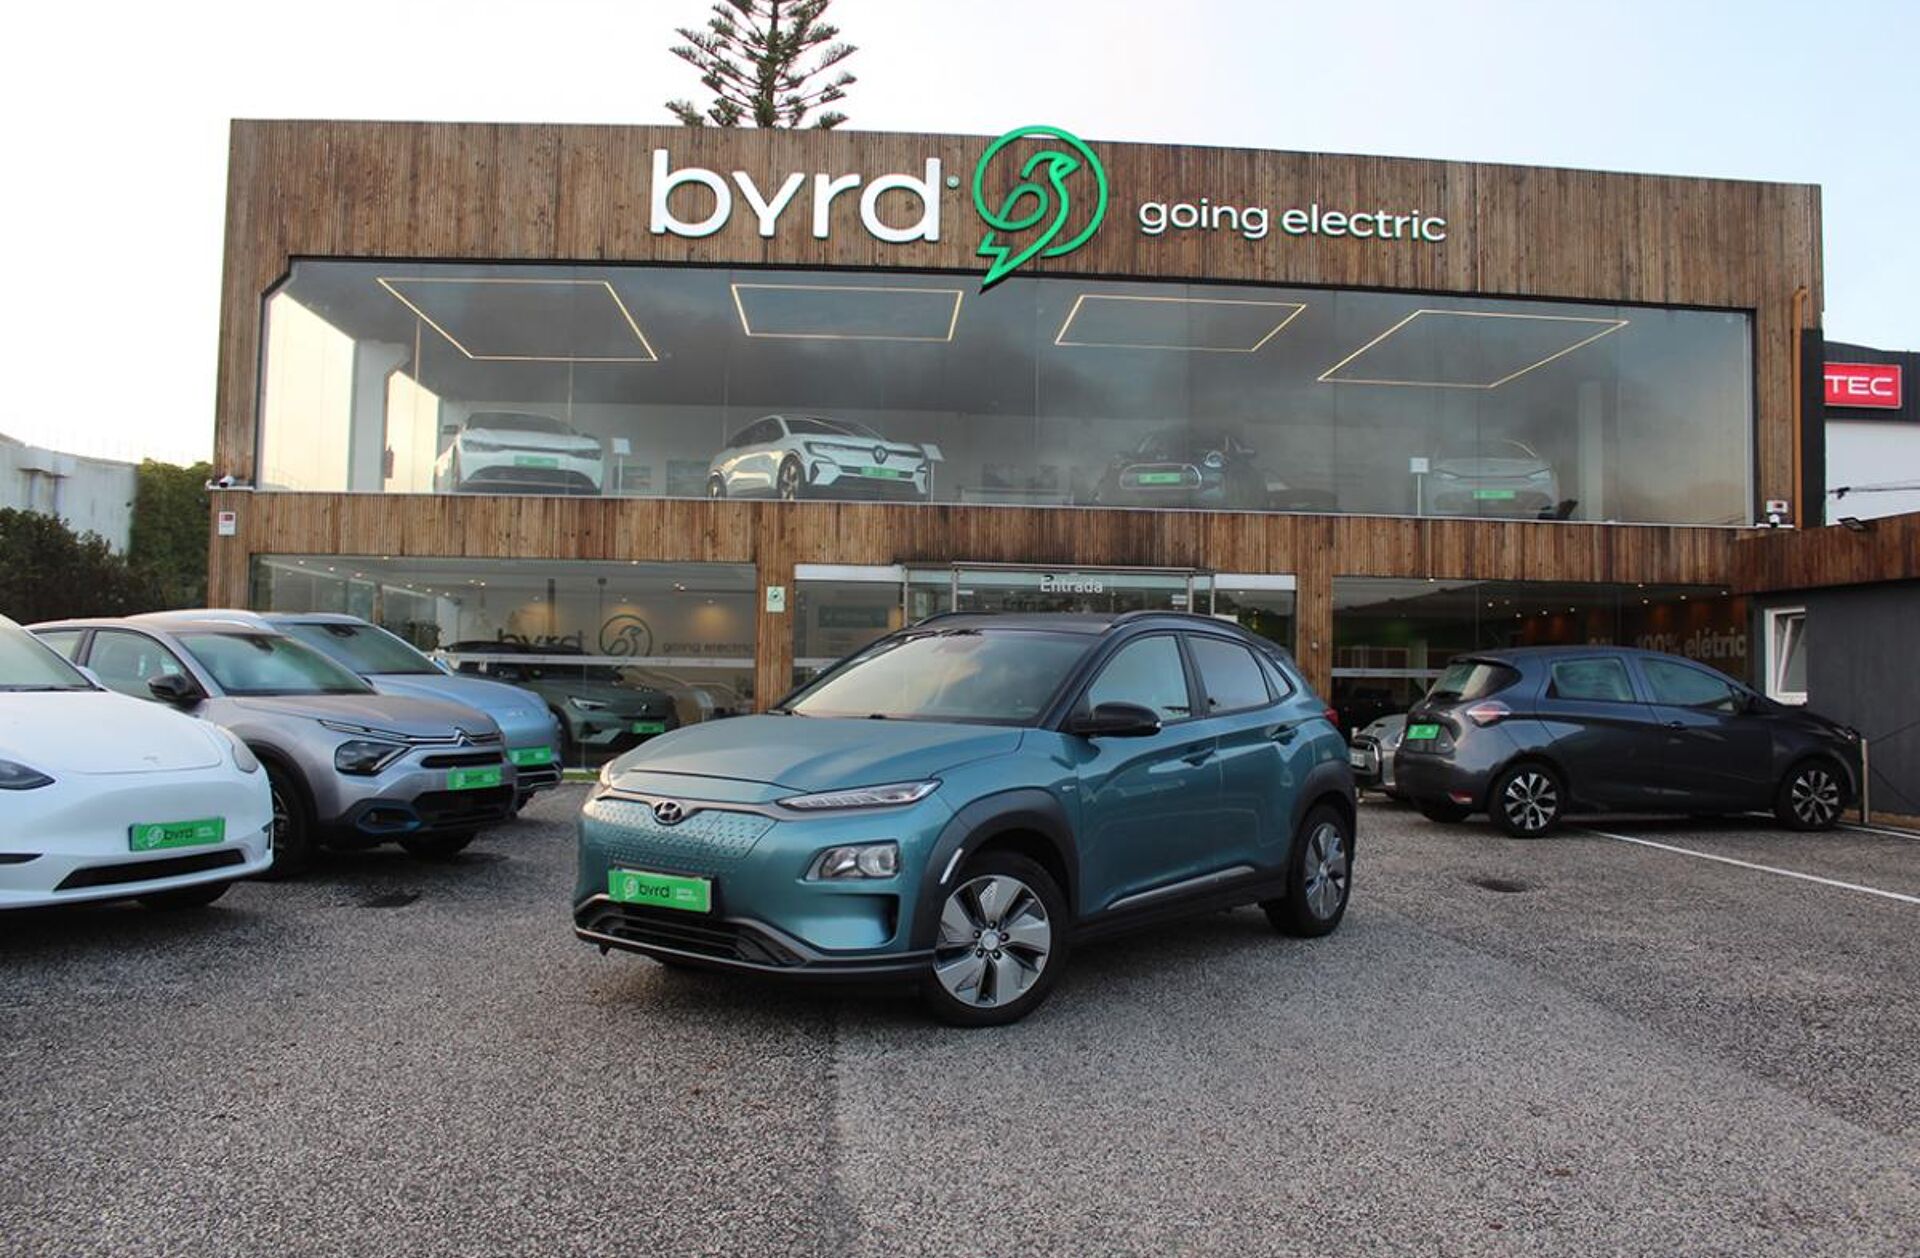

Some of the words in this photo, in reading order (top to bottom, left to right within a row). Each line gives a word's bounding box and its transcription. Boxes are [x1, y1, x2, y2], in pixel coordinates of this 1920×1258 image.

[650, 149, 941, 242] byrd
[1139, 198, 1268, 239] going
[1282, 203, 1447, 241] electric
[1824, 375, 1893, 396] TEC
[1040, 578, 1104, 593] Entrada
[163, 828, 193, 841] byrd
[639, 883, 670, 898] byrd
